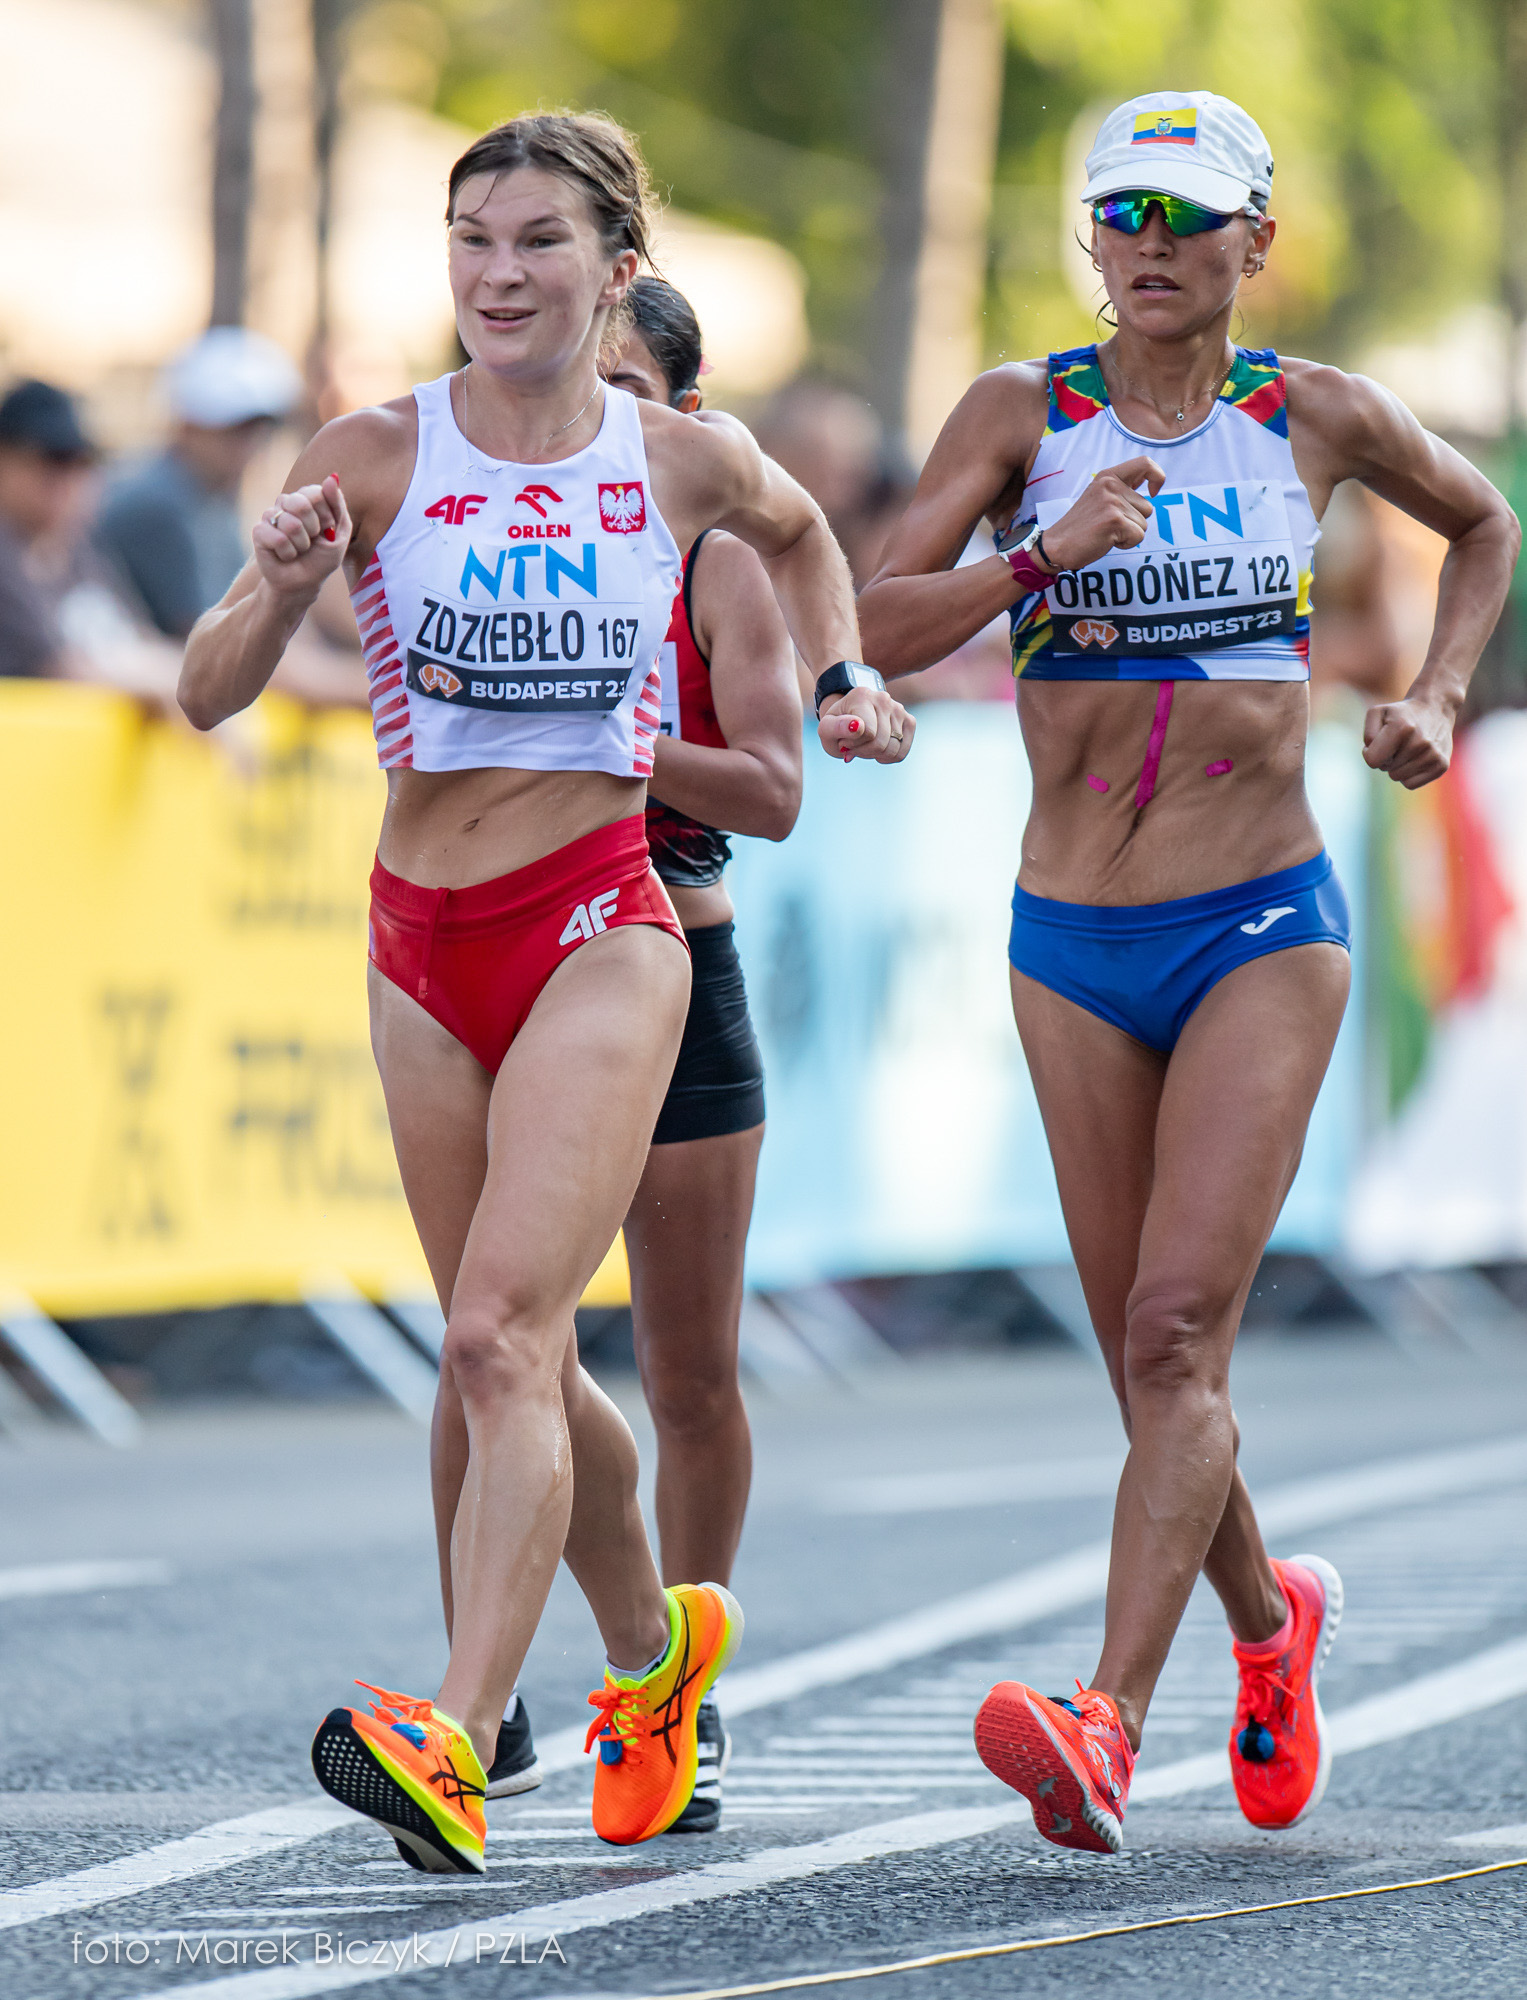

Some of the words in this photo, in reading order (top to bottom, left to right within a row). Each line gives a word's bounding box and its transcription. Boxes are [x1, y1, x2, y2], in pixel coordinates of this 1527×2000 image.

[507, 524, 571, 539] ORLEN
[1136, 487, 1243, 548] TN
[459, 543, 598, 601] NTN
[1247, 555, 1291, 595] 122
[415, 597, 585, 663] ZDZIEBŁO
[598, 618, 639, 659] 167
[1127, 615, 1254, 643] BUDAPEST
[1256, 609, 1282, 628] 23
[470, 680, 602, 700] BUDAPEST
